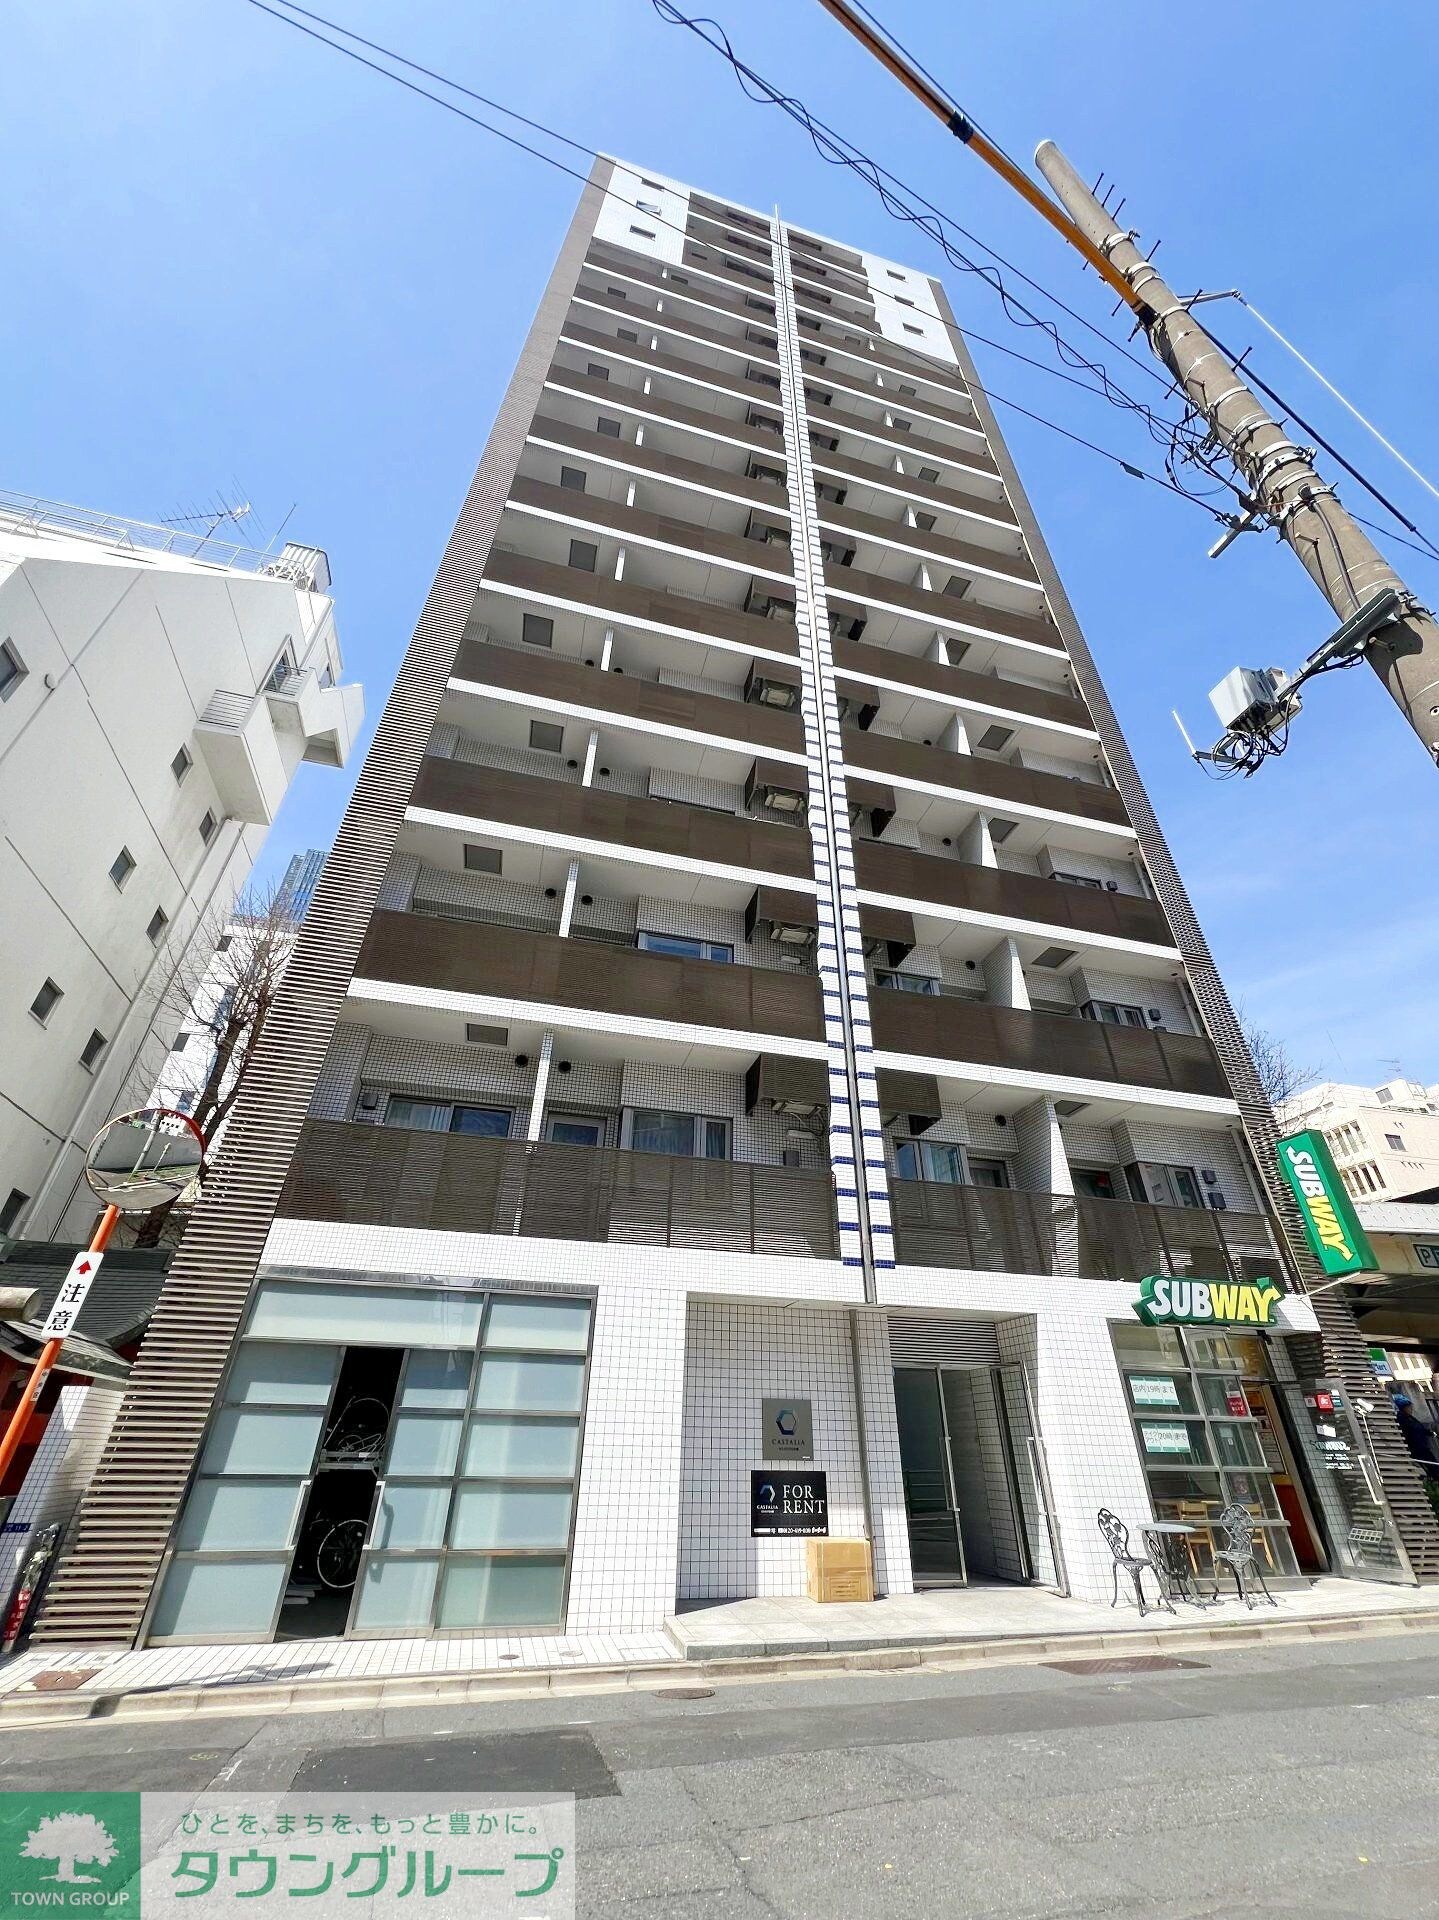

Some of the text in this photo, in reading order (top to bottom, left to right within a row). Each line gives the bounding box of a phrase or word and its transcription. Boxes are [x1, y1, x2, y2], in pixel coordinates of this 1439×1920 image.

[1286, 1145, 1354, 1261] SUBWAY
[47, 1283, 85, 1331] 注意
[1146, 1279, 1281, 1322] SUBWAY
[783, 1484, 814, 1499] FOR
[783, 1500, 825, 1514] RENT
